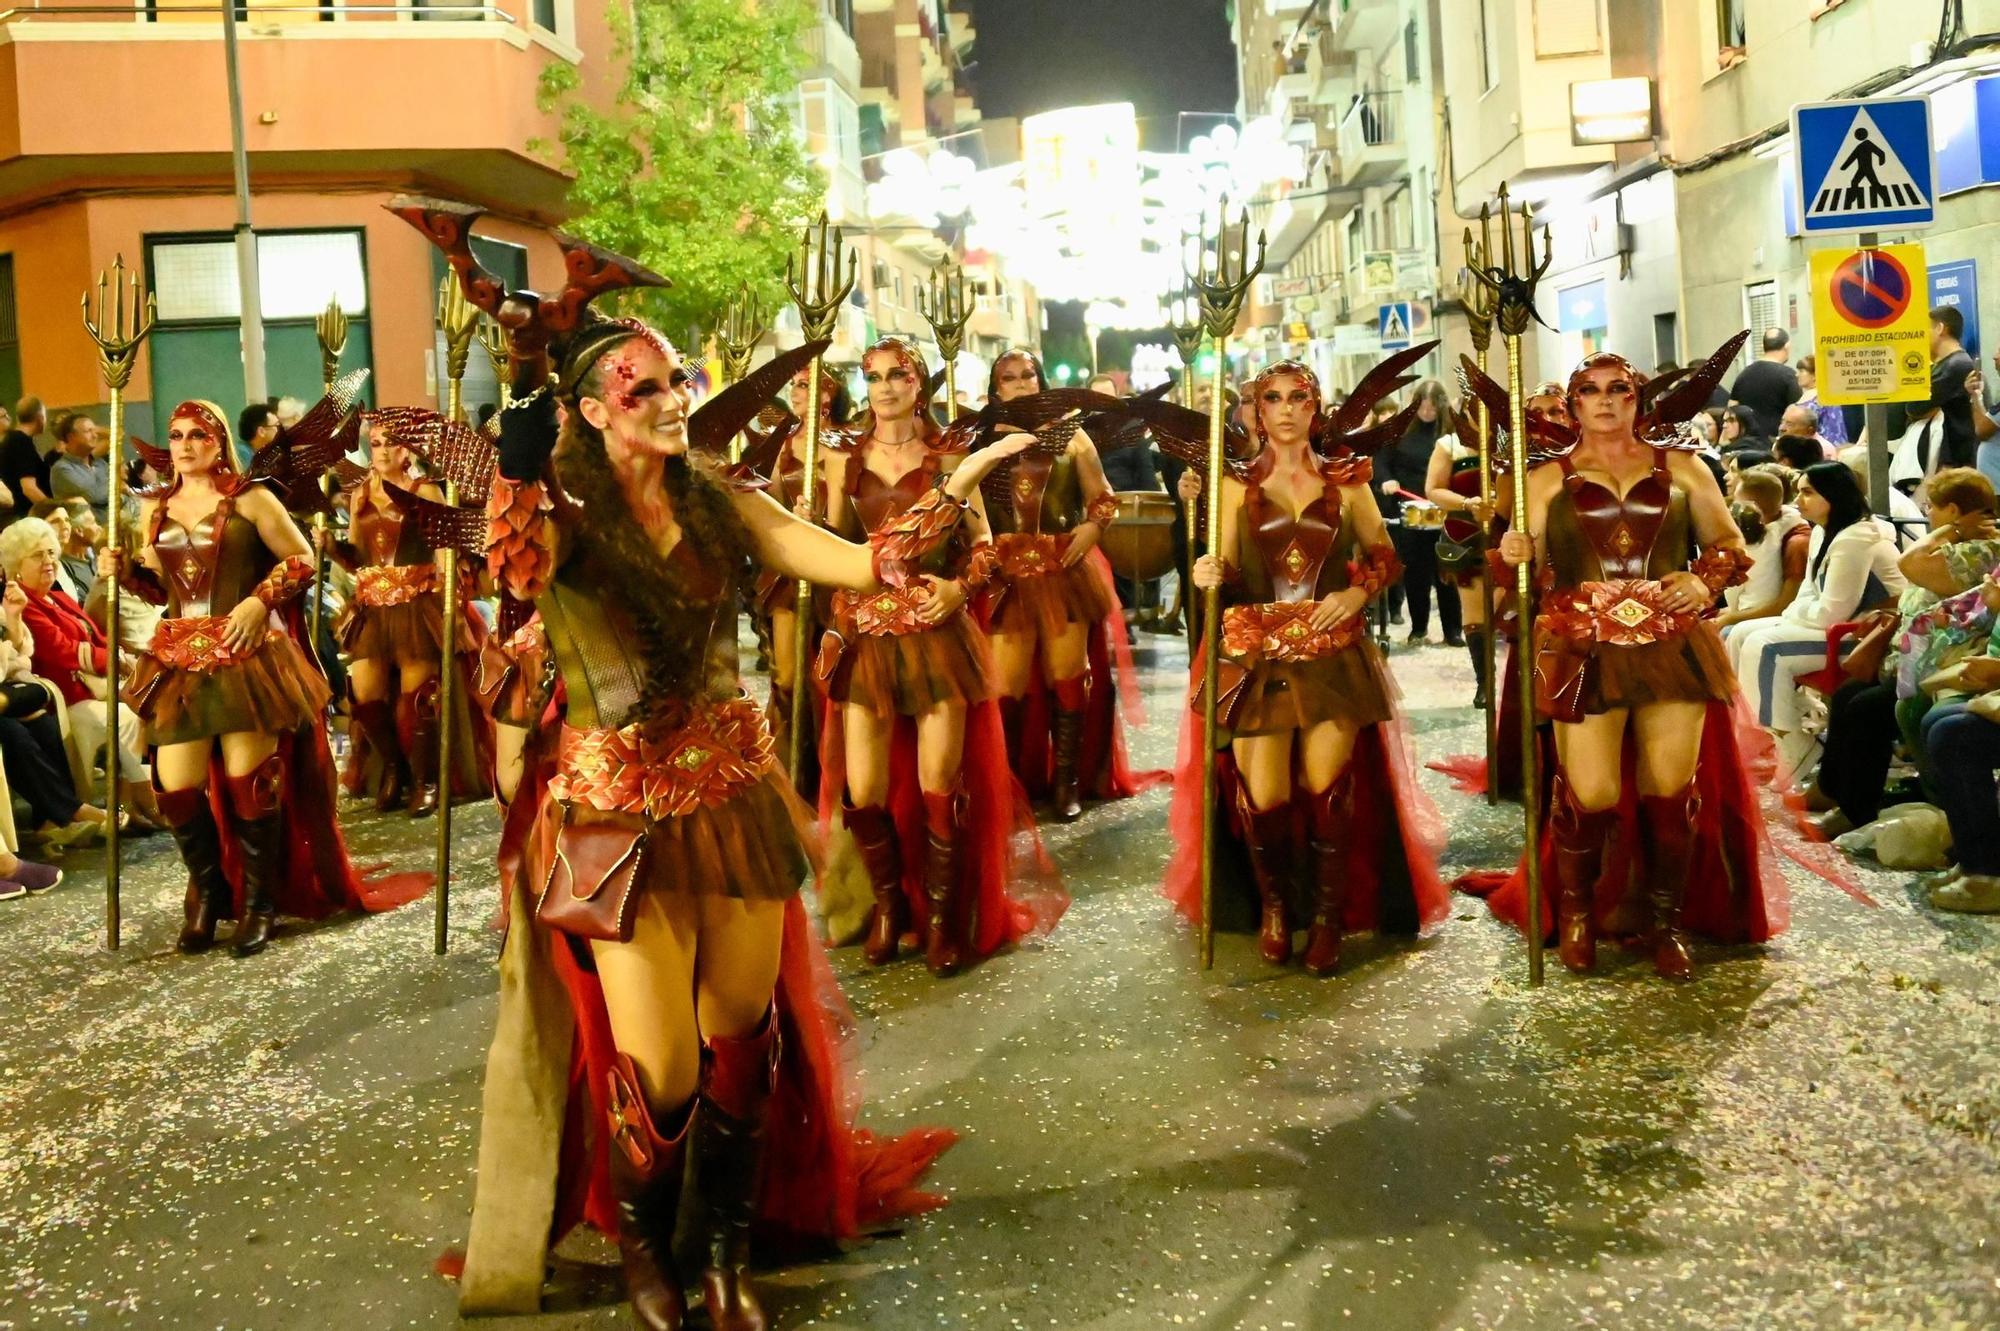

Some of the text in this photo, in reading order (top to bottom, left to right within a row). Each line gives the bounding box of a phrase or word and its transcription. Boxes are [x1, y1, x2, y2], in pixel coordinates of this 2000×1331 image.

[1820, 330, 1925, 345] PROHIBIDO ESTACIONAR
[1845, 350, 1857, 358] DE
